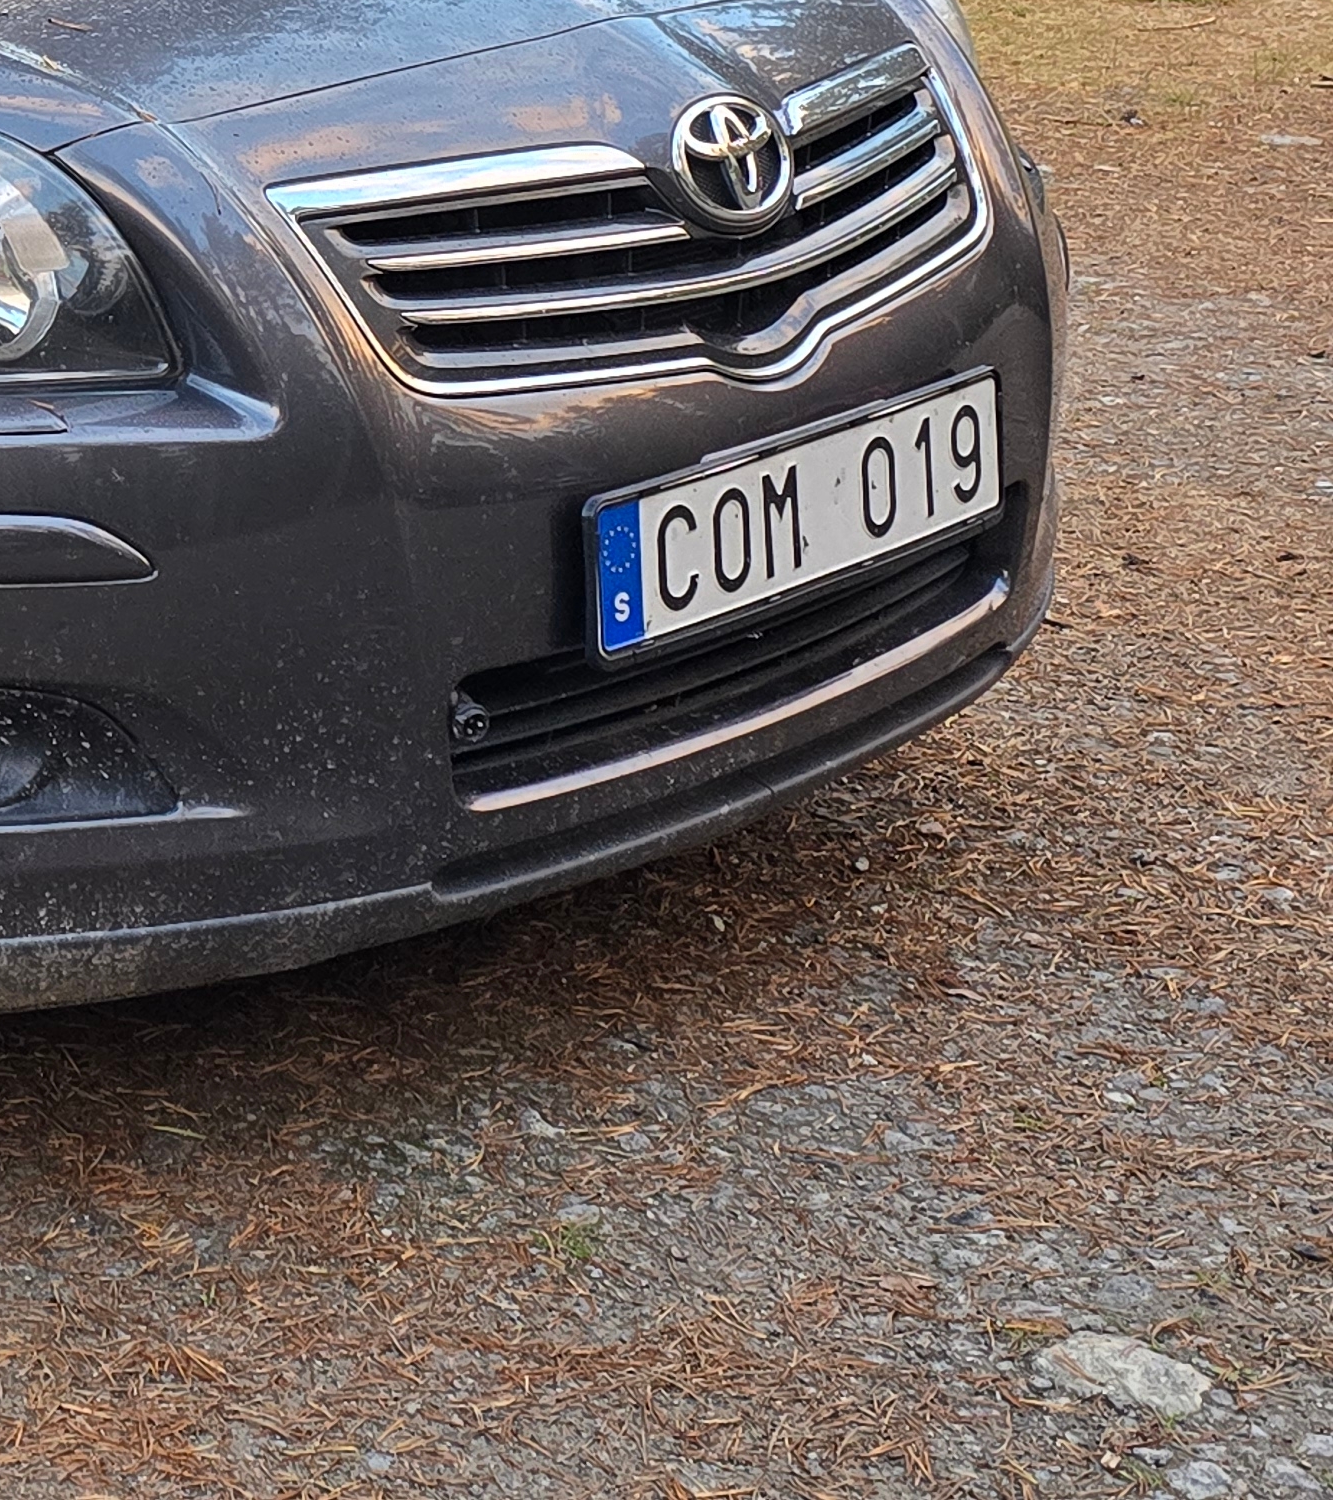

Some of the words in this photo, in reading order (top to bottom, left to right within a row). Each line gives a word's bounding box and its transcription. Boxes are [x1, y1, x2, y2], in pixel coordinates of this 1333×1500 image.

[656, 464, 803, 612] COM
[861, 404, 983, 540] 019
[613, 591, 631, 623] S
